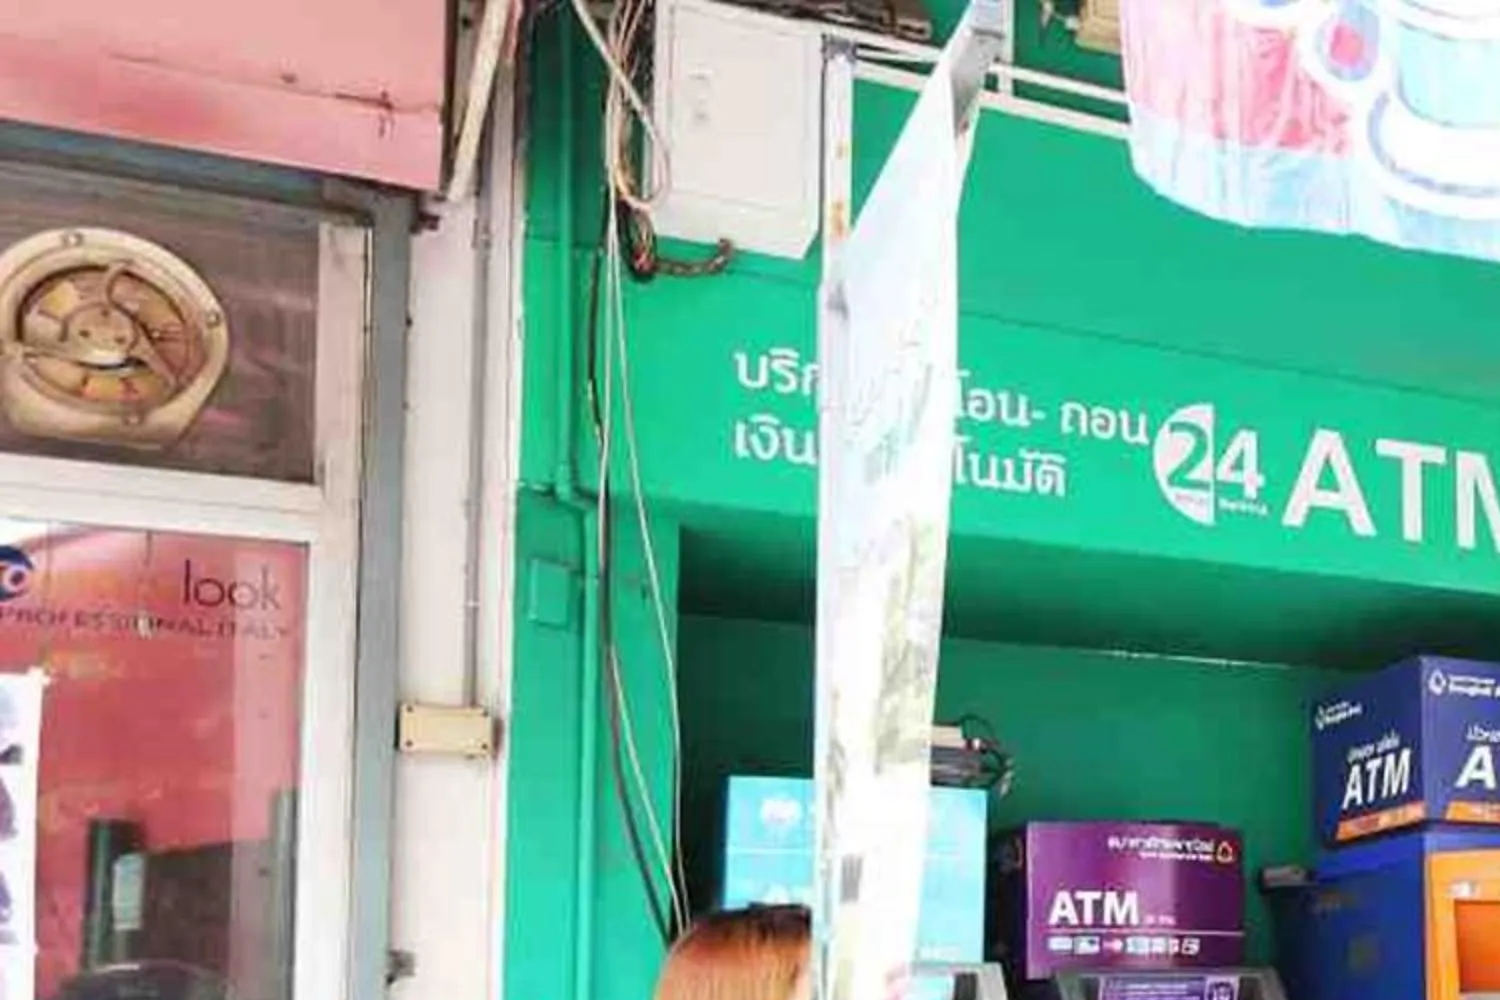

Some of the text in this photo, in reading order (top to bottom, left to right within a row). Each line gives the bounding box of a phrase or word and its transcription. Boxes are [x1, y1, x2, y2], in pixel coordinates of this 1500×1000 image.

[734, 412, 819, 467] เงิน
[1060, 401, 1150, 446] ถอน
[1164, 416, 1266, 501] 24
[181, 558, 282, 610] look
[1342, 747, 1412, 811] ATM
[1047, 889, 1141, 927] ATM
